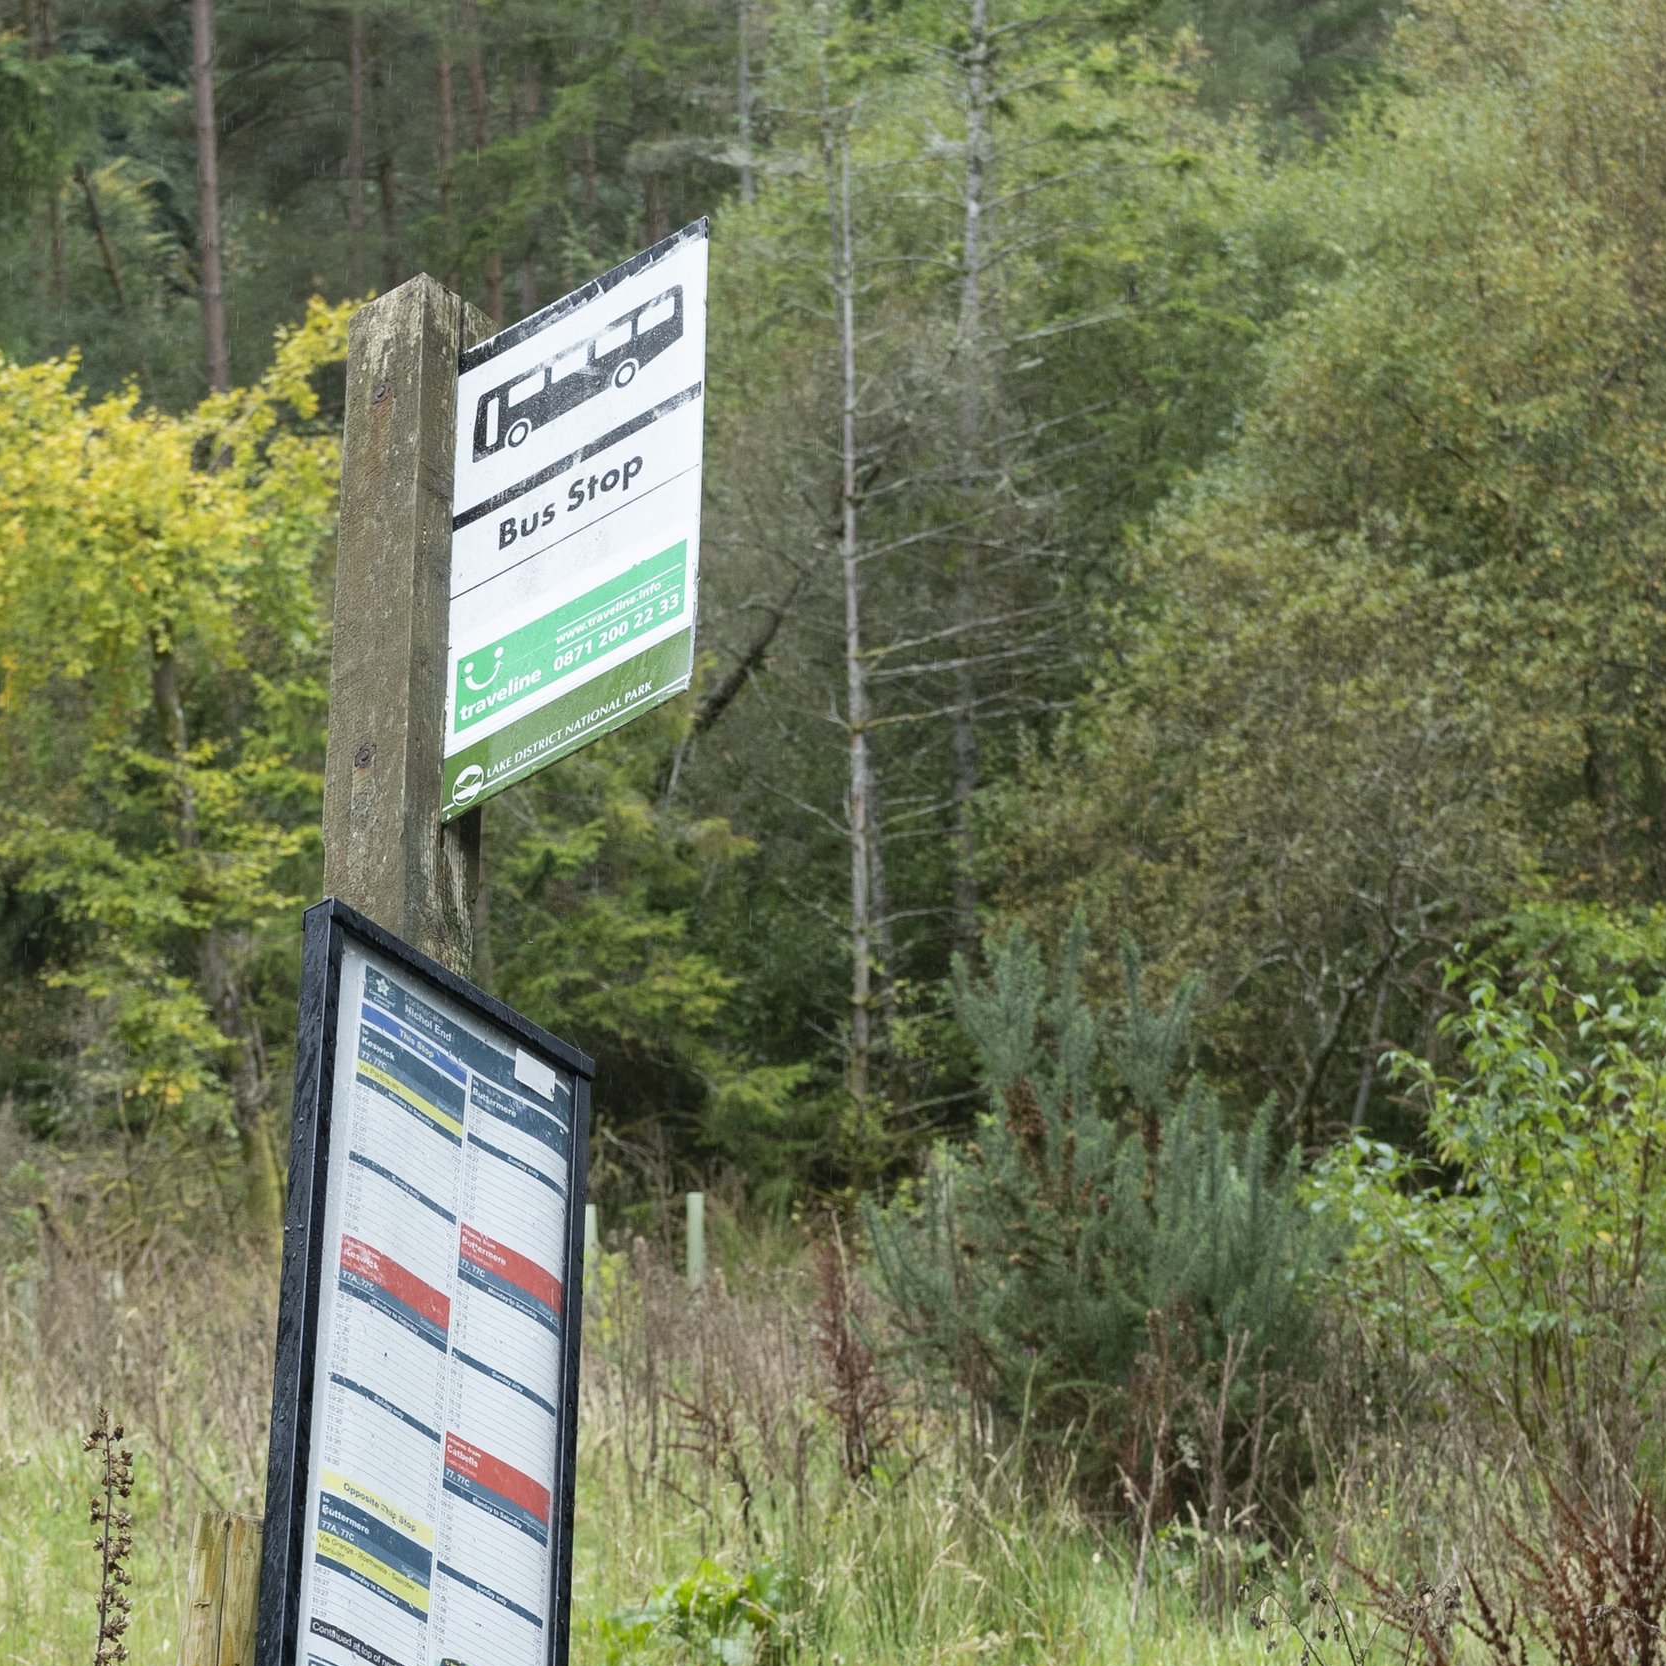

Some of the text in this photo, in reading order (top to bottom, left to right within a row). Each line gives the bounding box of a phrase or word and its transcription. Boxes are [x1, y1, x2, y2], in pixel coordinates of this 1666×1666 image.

[499, 456, 643, 550] Bus Stop
[555, 580, 661, 645] www.traveline.info
[553, 593, 679, 671] 0871 200 22 33
[459, 668, 541, 721] traveline
[486, 680, 653, 778] LAKE DISTRICT NATIONAL PARK
[404, 1004, 434, 1030] Nichol
[434, 1024, 453, 1043] End
[361, 1036, 396, 1062] Keswick
[399, 1028, 416, 1047] This
[416, 1041, 435, 1059] Stop
[473, 1087, 518, 1119] Buttermere
[462, 1235, 508, 1267] Buttermere
[447, 1445, 479, 1469] Catbells
[457, 1474, 472, 1488] 77C
[322, 1504, 371, 1536] Buttermere
[343, 1483, 381, 1509] Opposite
[398, 1515, 417, 1533] Stop
[320, 1533, 330, 1544] Via
[340, 1528, 356, 1543] 77C
[312, 1621, 353, 1648] Continued
[353, 1641, 362, 1654] at
[361, 1644, 374, 1660] top
[373, 1654, 383, 1664] of
